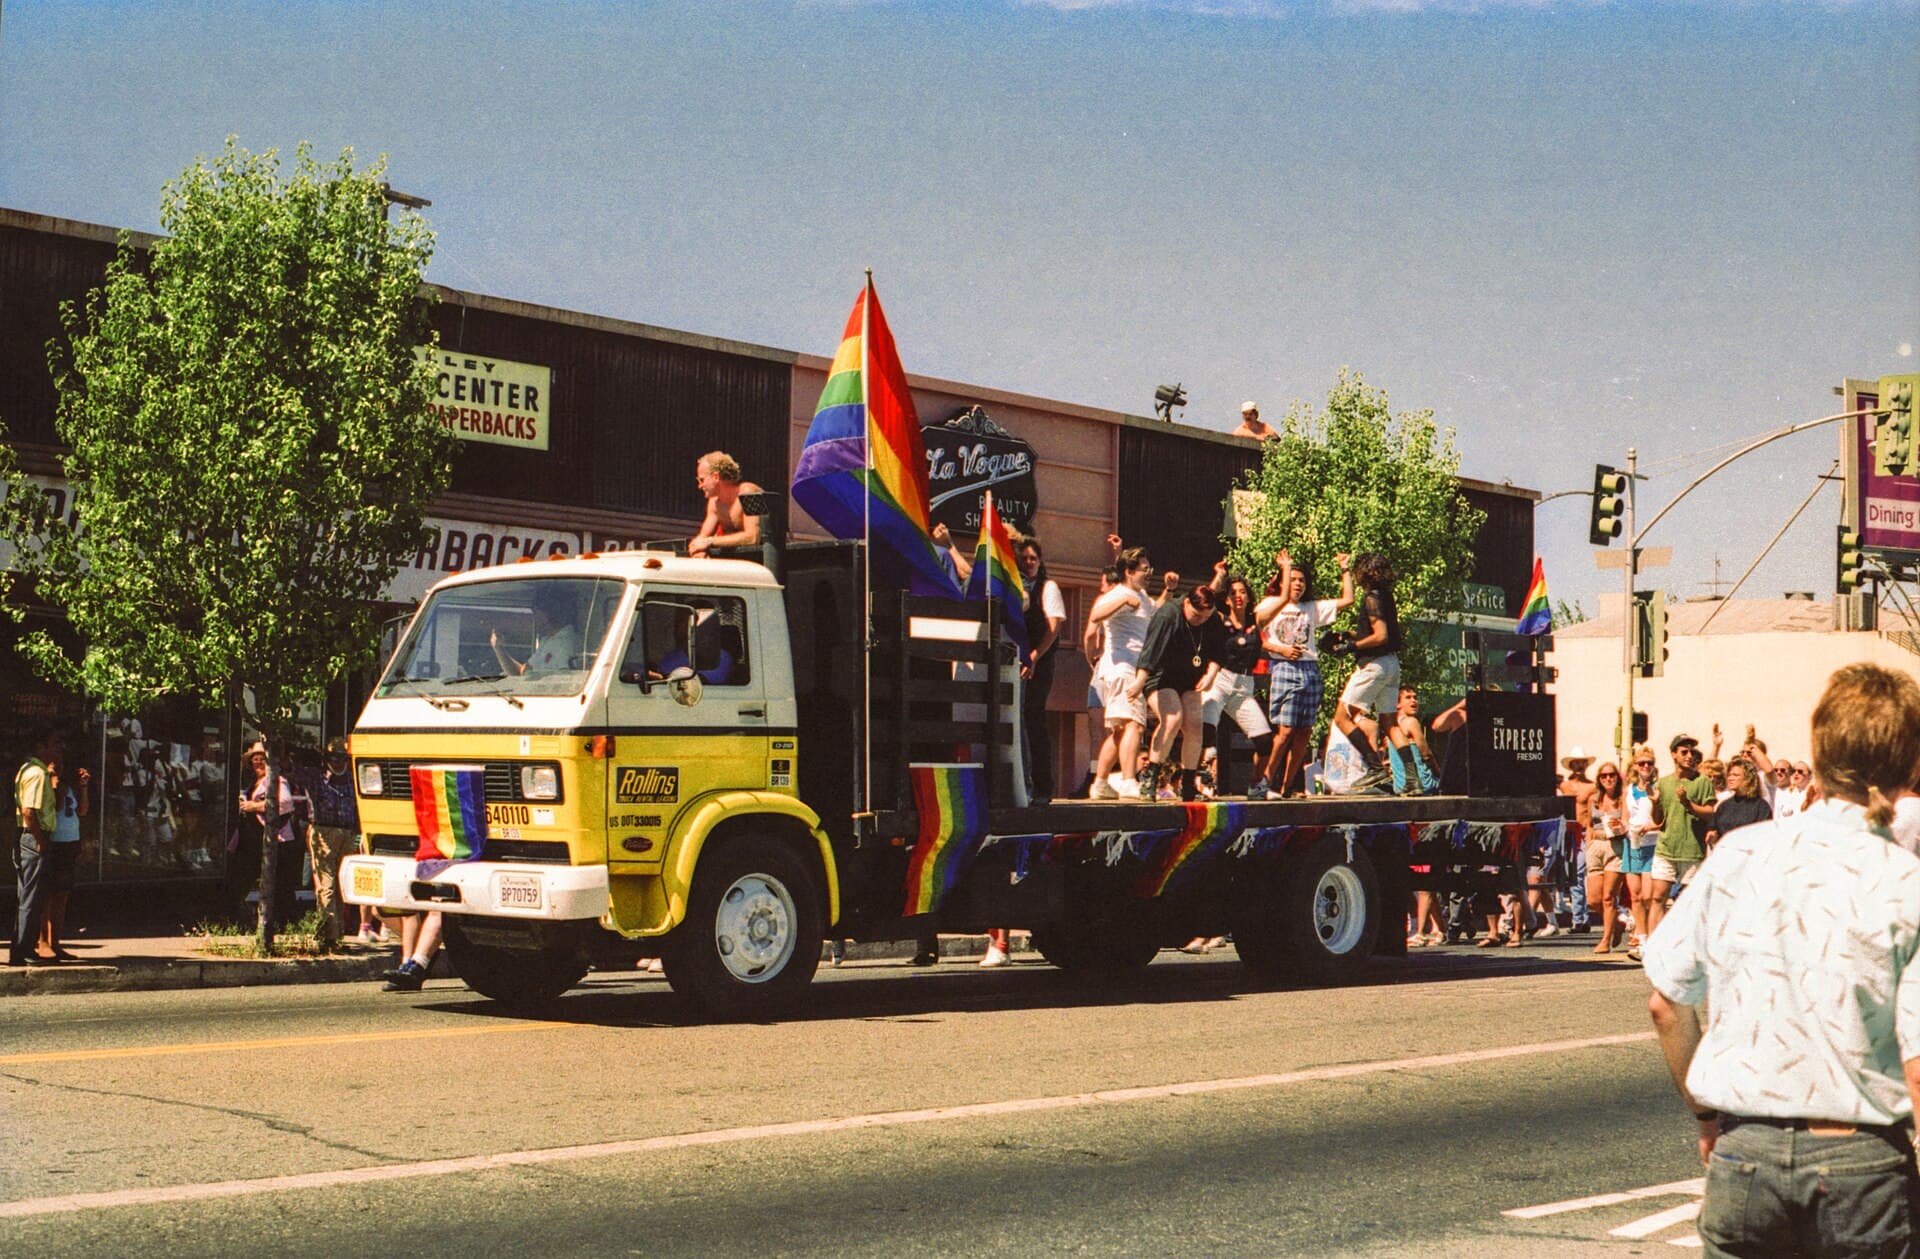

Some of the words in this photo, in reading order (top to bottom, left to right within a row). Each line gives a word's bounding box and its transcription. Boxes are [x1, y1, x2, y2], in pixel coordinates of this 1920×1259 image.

[437, 372, 539, 412] CENTER
[926, 448, 957, 480] La
[958, 443, 1031, 481] Vogue
[979, 496, 1029, 516] BAUTY
[1869, 504, 1914, 528] Dining
[1462, 585, 1504, 609] Service
[1493, 717, 1504, 726] THE
[1493, 727, 1543, 751] EXPRESS
[1517, 752, 1543, 761] FRESNO
[619, 768, 677, 795] Rollins
[486, 805, 530, 825] 640110
[609, 816, 619, 827] US
